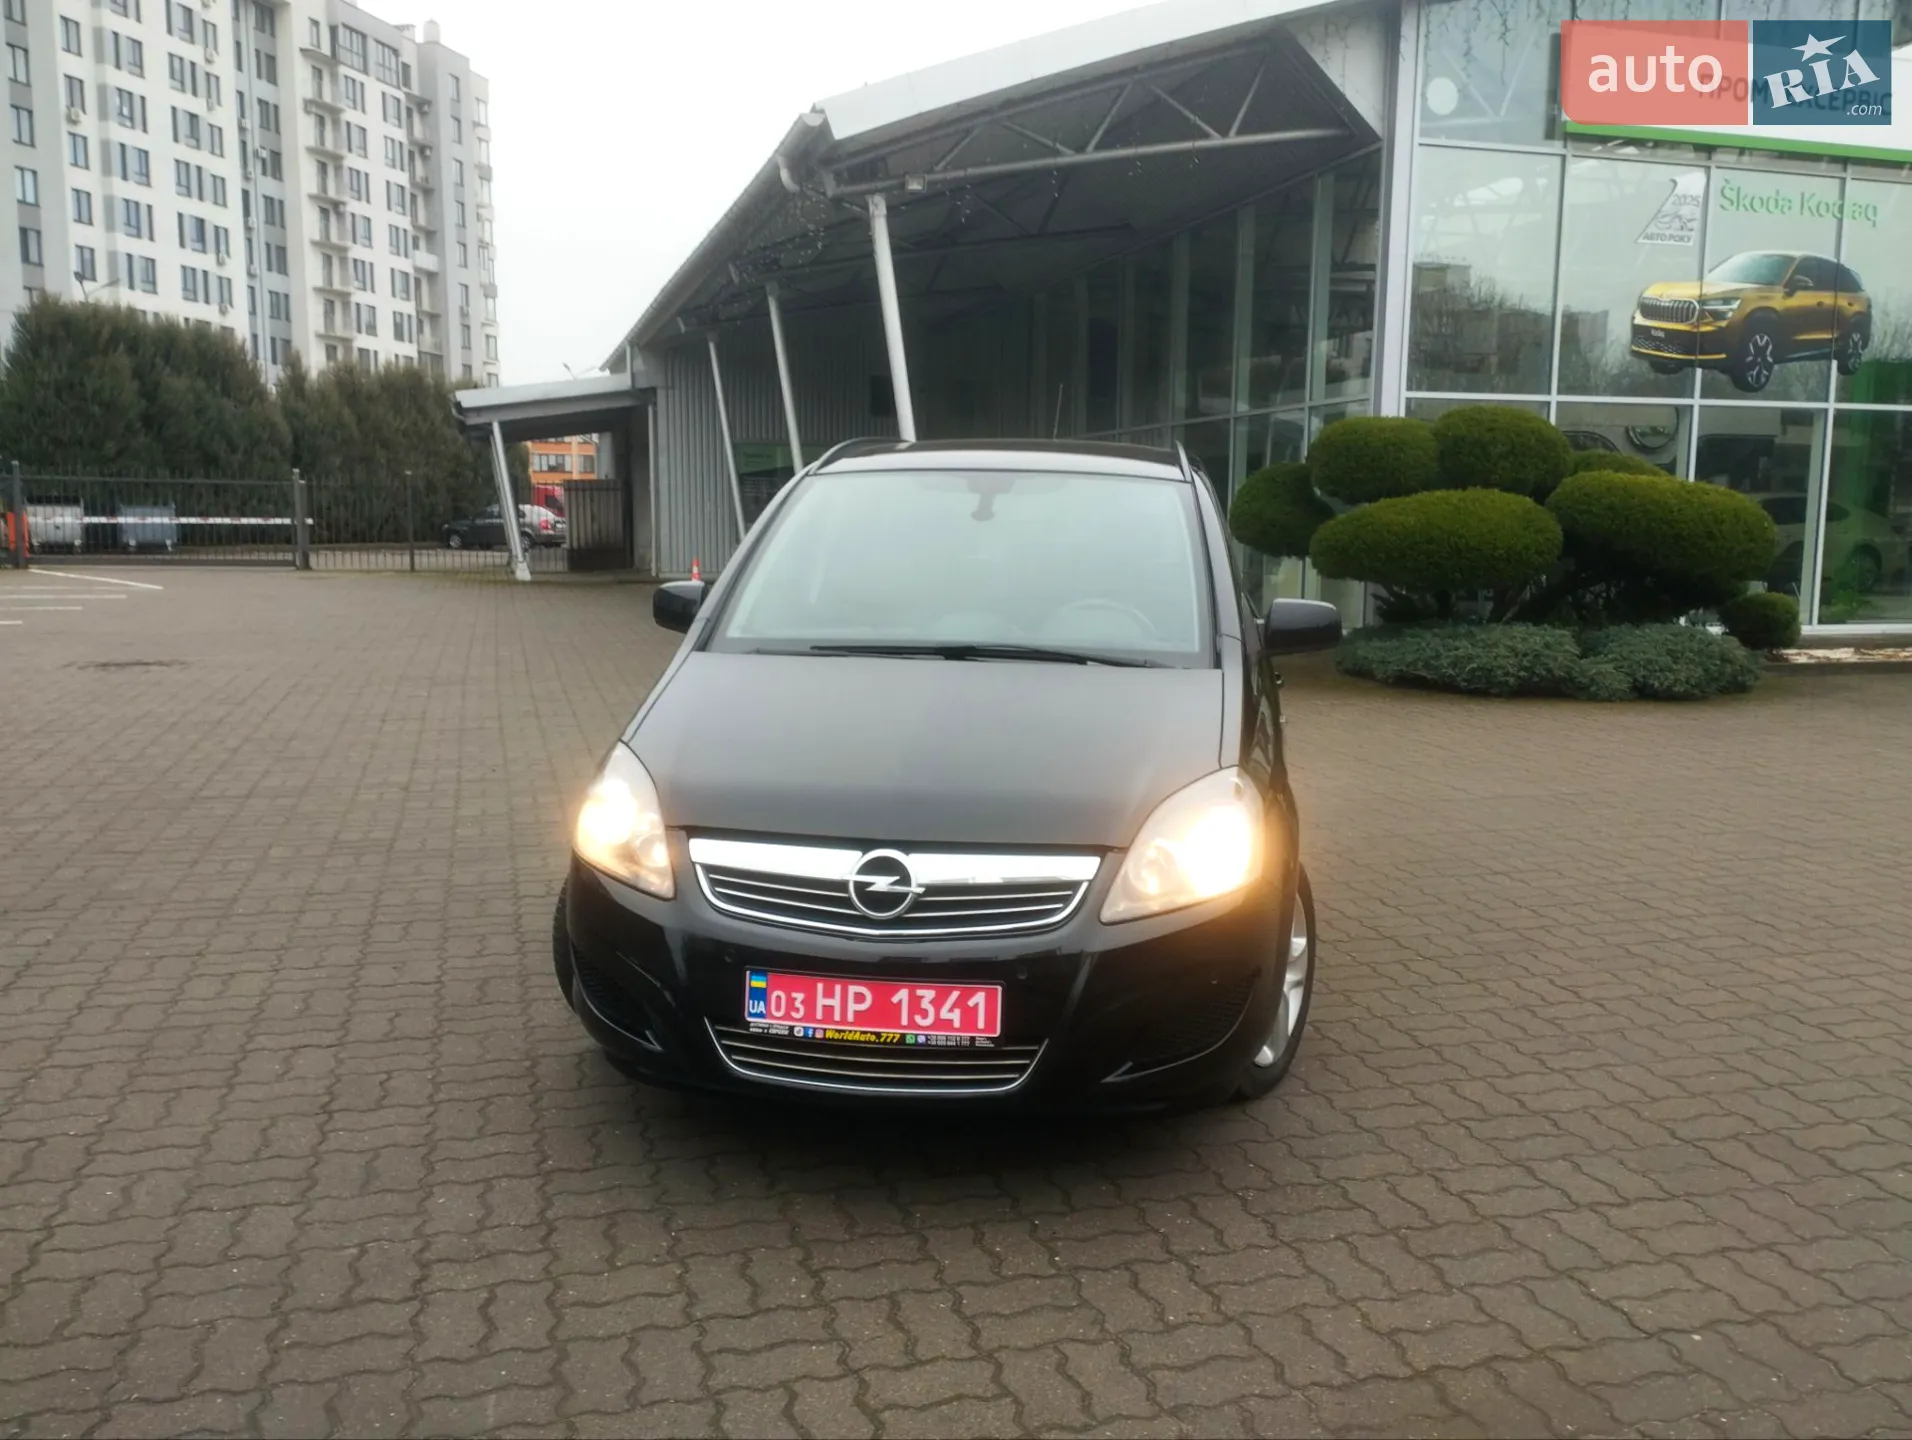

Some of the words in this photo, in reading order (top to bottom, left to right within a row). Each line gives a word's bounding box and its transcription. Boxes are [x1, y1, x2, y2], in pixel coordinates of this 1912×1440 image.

[1671, 193, 1701, 208] 2025
[1720, 178, 1792, 215] Škoda
[1800, 191, 1878, 228] Kodaq
[749, 1000, 766, 1015] UA
[770, 990, 805, 1019] 03
[891, 988, 986, 1030] 1341
